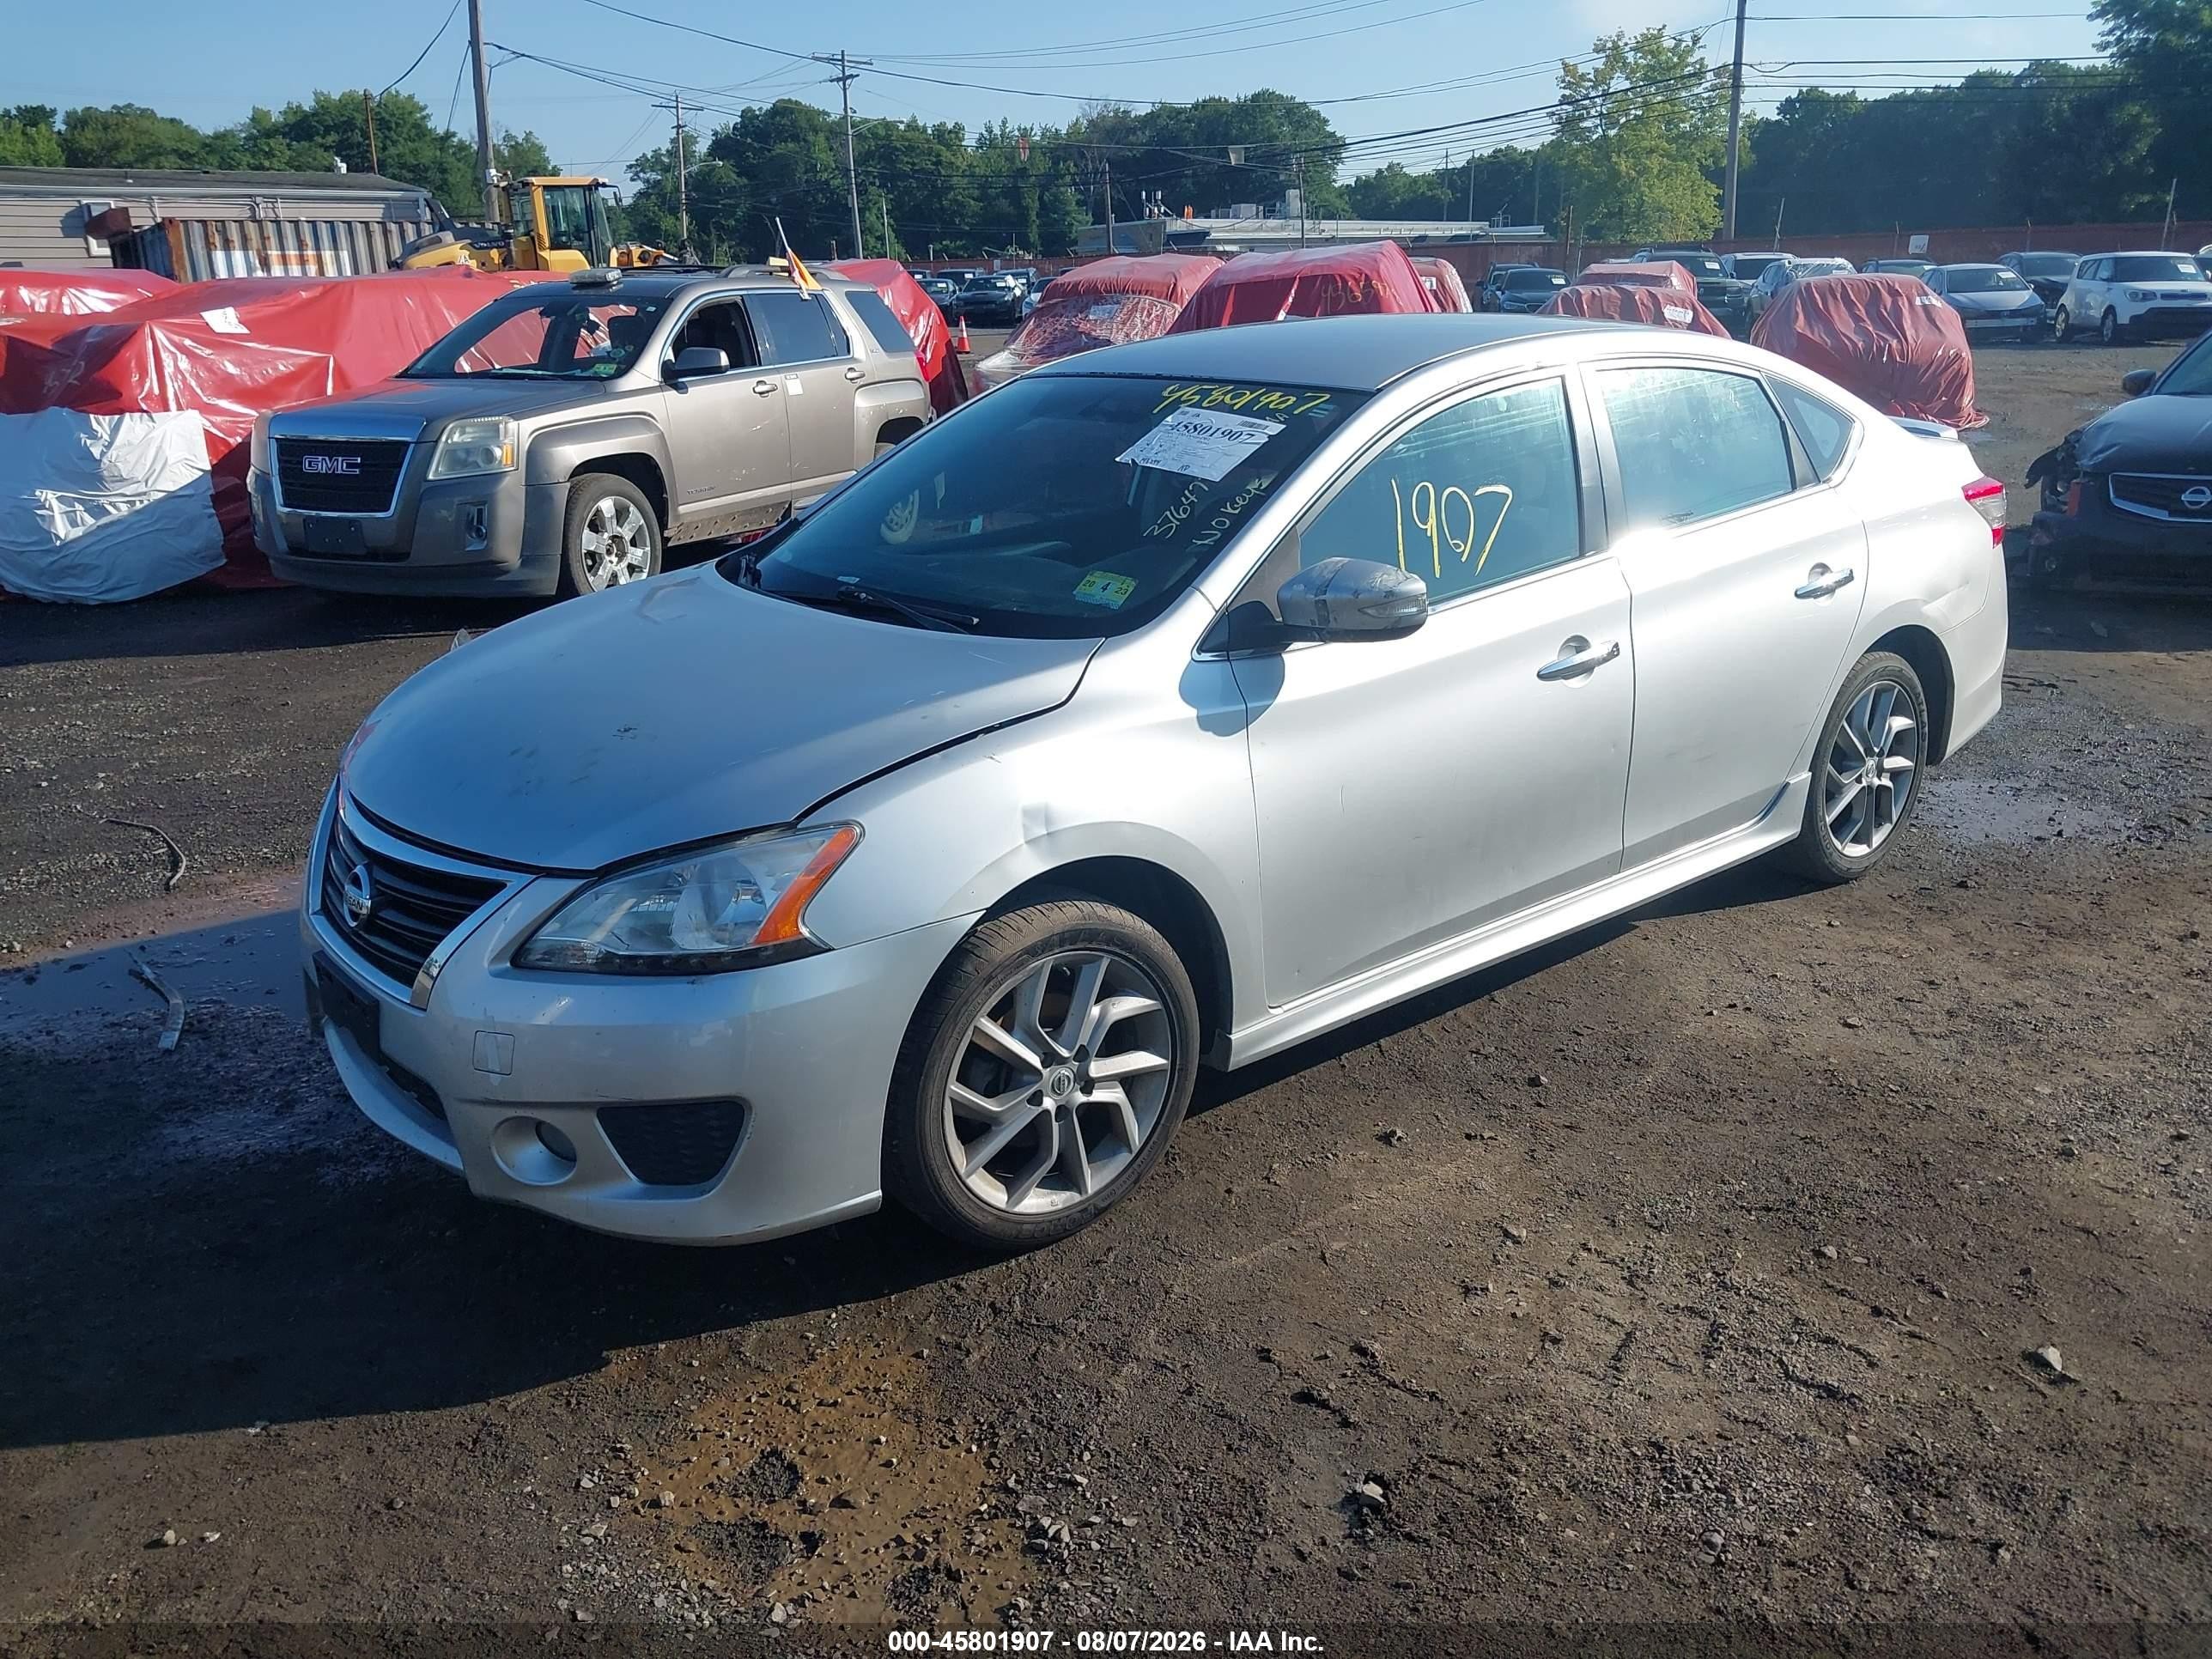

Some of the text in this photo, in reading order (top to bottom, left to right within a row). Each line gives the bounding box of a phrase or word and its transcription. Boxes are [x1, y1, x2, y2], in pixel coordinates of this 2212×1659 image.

[1152, 383, 1331, 415] 45801907
[1168, 420, 1255, 444] 45801907
[302, 455, 361, 475] GMC
[1390, 477, 1513, 579] 1907
[1100, 581, 1112, 592] 4
[1114, 587, 1129, 596] 23
